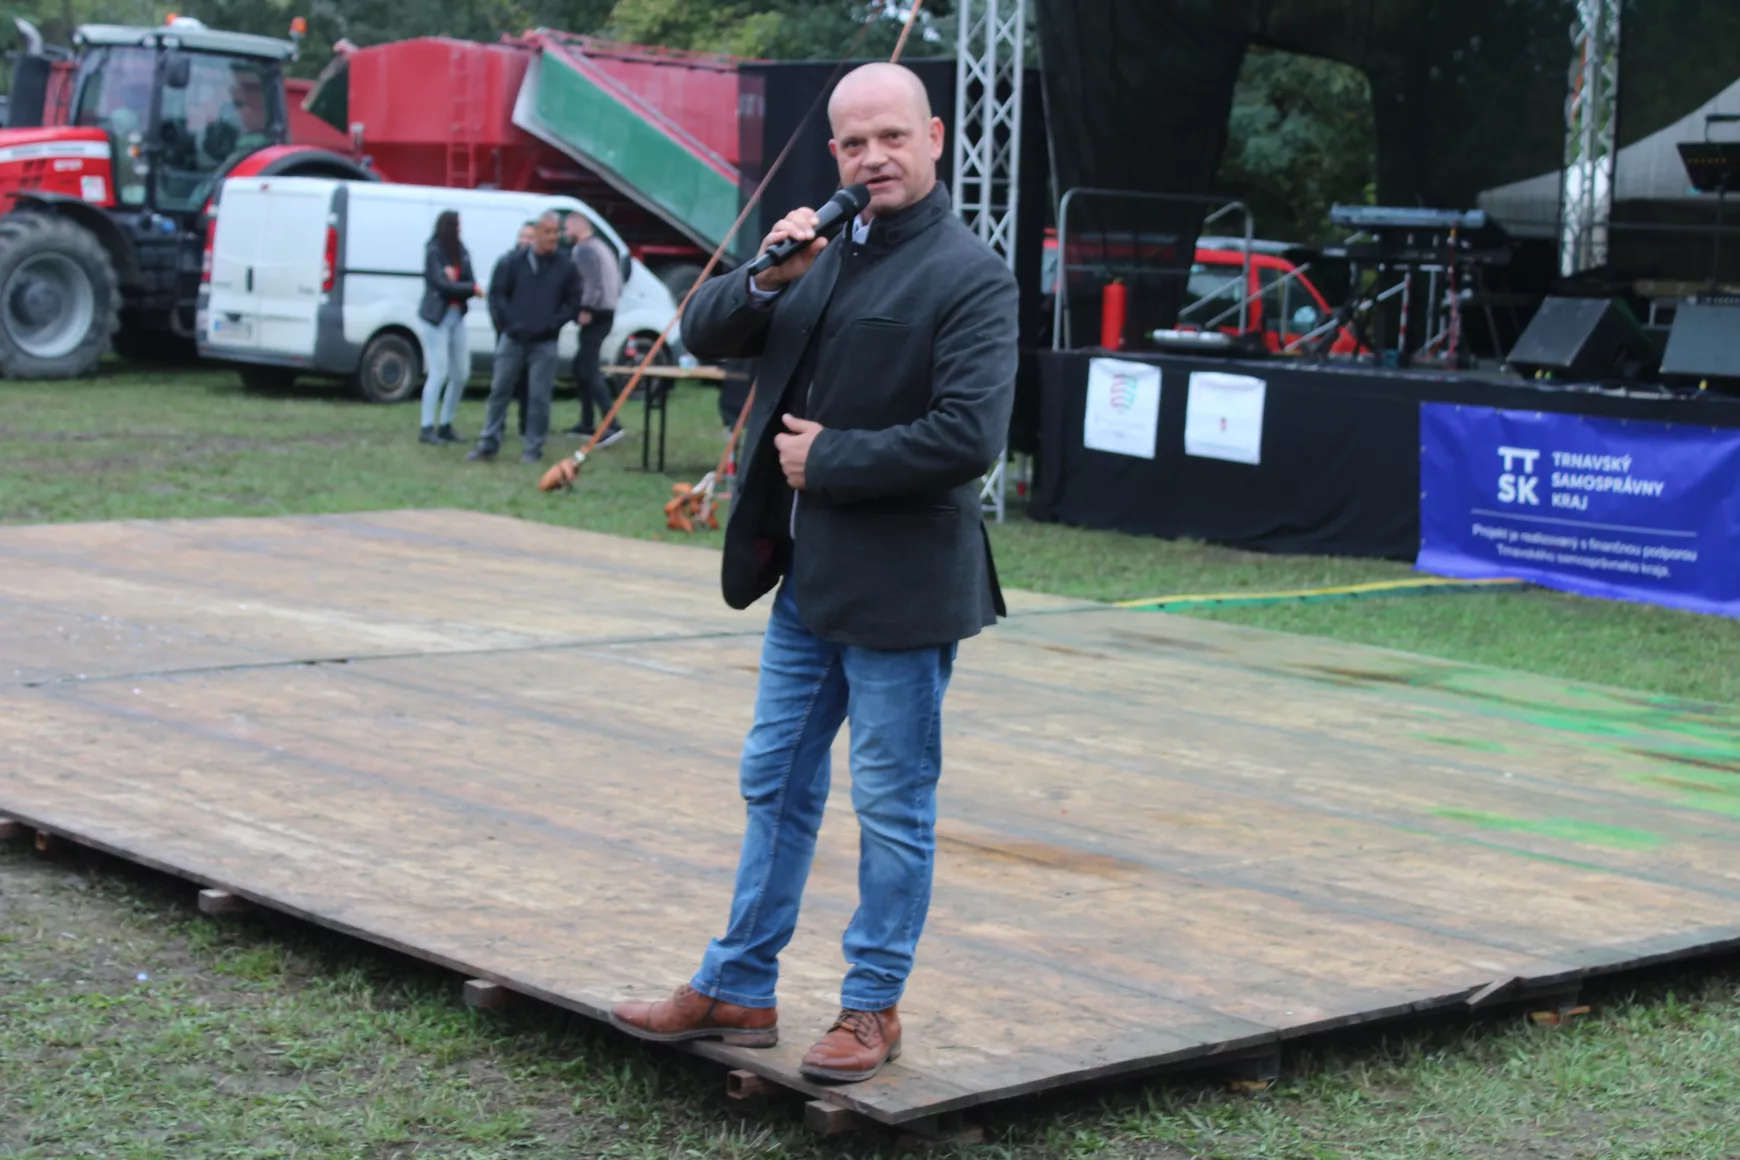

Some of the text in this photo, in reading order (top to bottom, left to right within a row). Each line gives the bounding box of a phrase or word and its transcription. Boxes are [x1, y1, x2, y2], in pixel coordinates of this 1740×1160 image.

[1497, 446, 1540, 474] TT
[1551, 451, 1633, 473] TRNAVSKÝ
[1497, 472, 1540, 506] SK
[1551, 471, 1665, 497] SAMOSPRÁVNY
[1551, 492, 1589, 511] KRAJ
